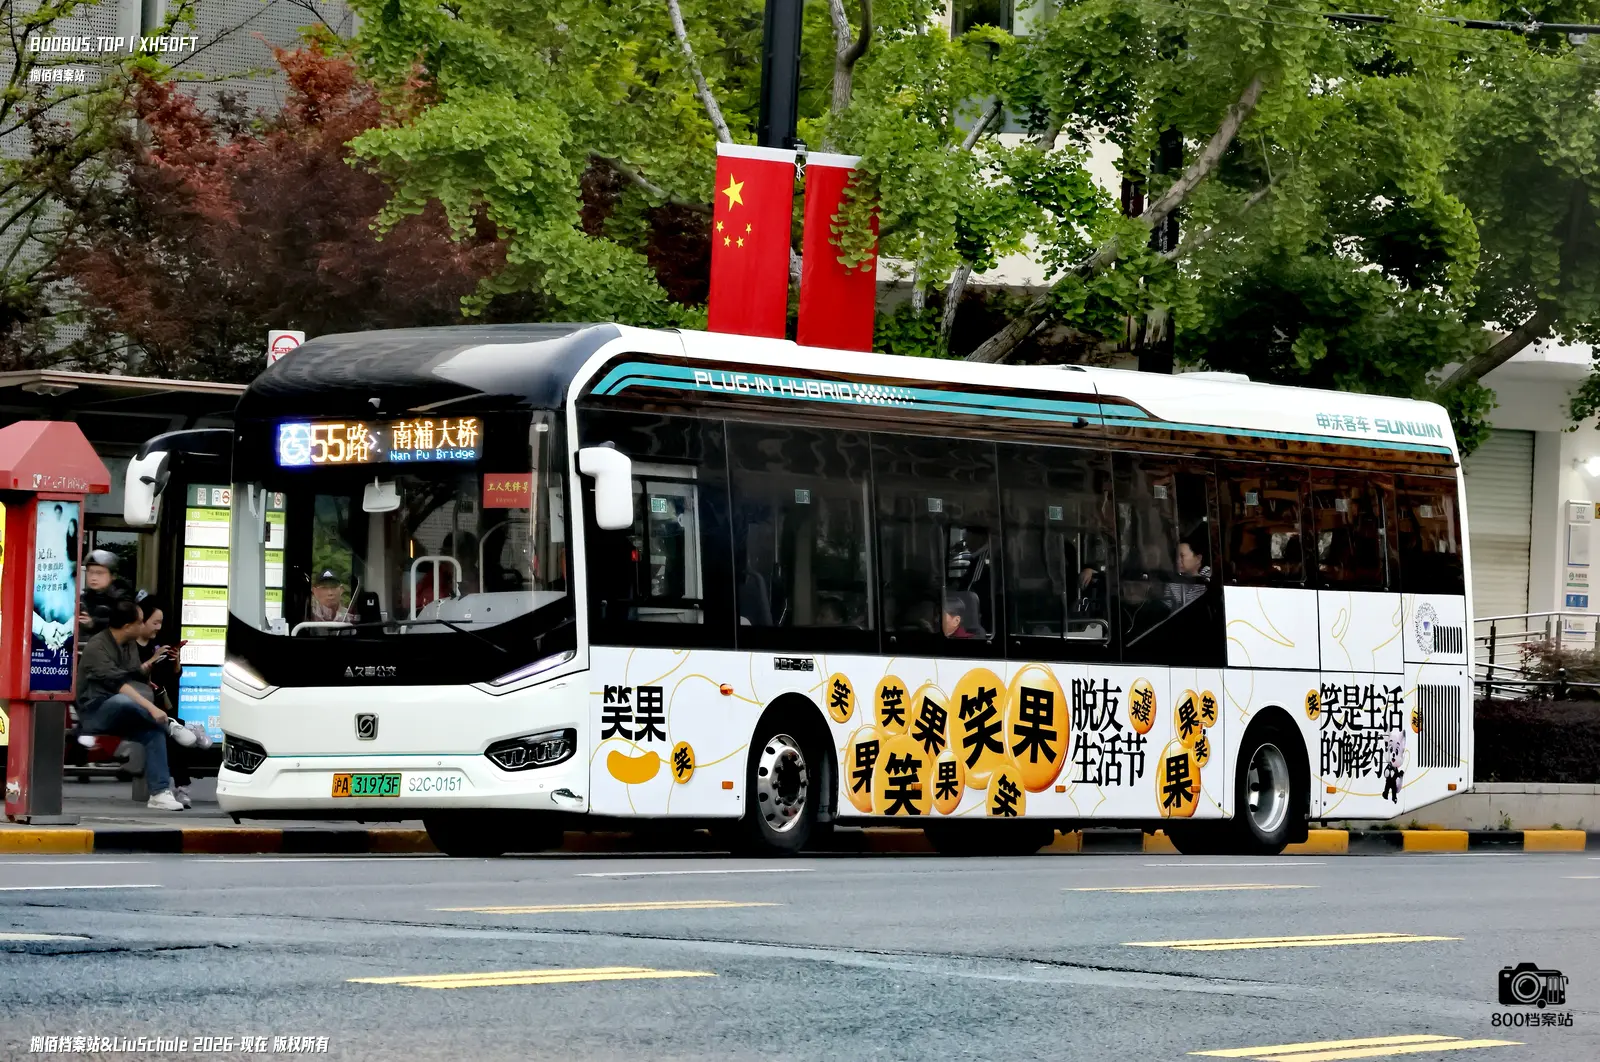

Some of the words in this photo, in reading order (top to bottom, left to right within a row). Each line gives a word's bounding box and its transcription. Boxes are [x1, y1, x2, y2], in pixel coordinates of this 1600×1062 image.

[694, 371, 774, 394] PLUG-IN
[779, 379, 852, 400] HYBRID
[311, 423, 368, 462] 55路
[391, 418, 479, 449] 南浦大桥
[1315, 412, 1371, 433] 申沃客车
[1374, 418, 1443, 438] SUNWIN
[390, 450, 410, 460] Nan
[416, 450, 430, 460] Pu
[436, 449, 475, 460] Bridge
[487, 481, 529, 494] 工人先锋号
[31, 667, 68, 675] 800-8200-666
[601, 685, 666, 742] 笑果
[831, 679, 850, 716] 笑
[881, 685, 906, 727] 笑
[1071, 678, 1123, 732] 脱友
[1201, 696, 1215, 721] 笑
[1307, 694, 1319, 715] 笑
[1319, 683, 1404, 732] 笑是生活
[912, 696, 948, 755] 果
[958, 687, 1004, 769] 笑
[1012, 686, 1057, 763] 果
[1178, 697, 1199, 740] 果
[674, 747, 692, 777] 笑
[1071, 732, 1147, 787] 生活节
[1194, 738, 1208, 762] 笑
[1320, 730, 1384, 779] 的解药
[409, 776, 462, 792] S2C-0151
[884, 752, 922, 815] 笑
[935, 760, 959, 800] 果
[992, 773, 1021, 817] 笑
[1163, 753, 1194, 808] 果
